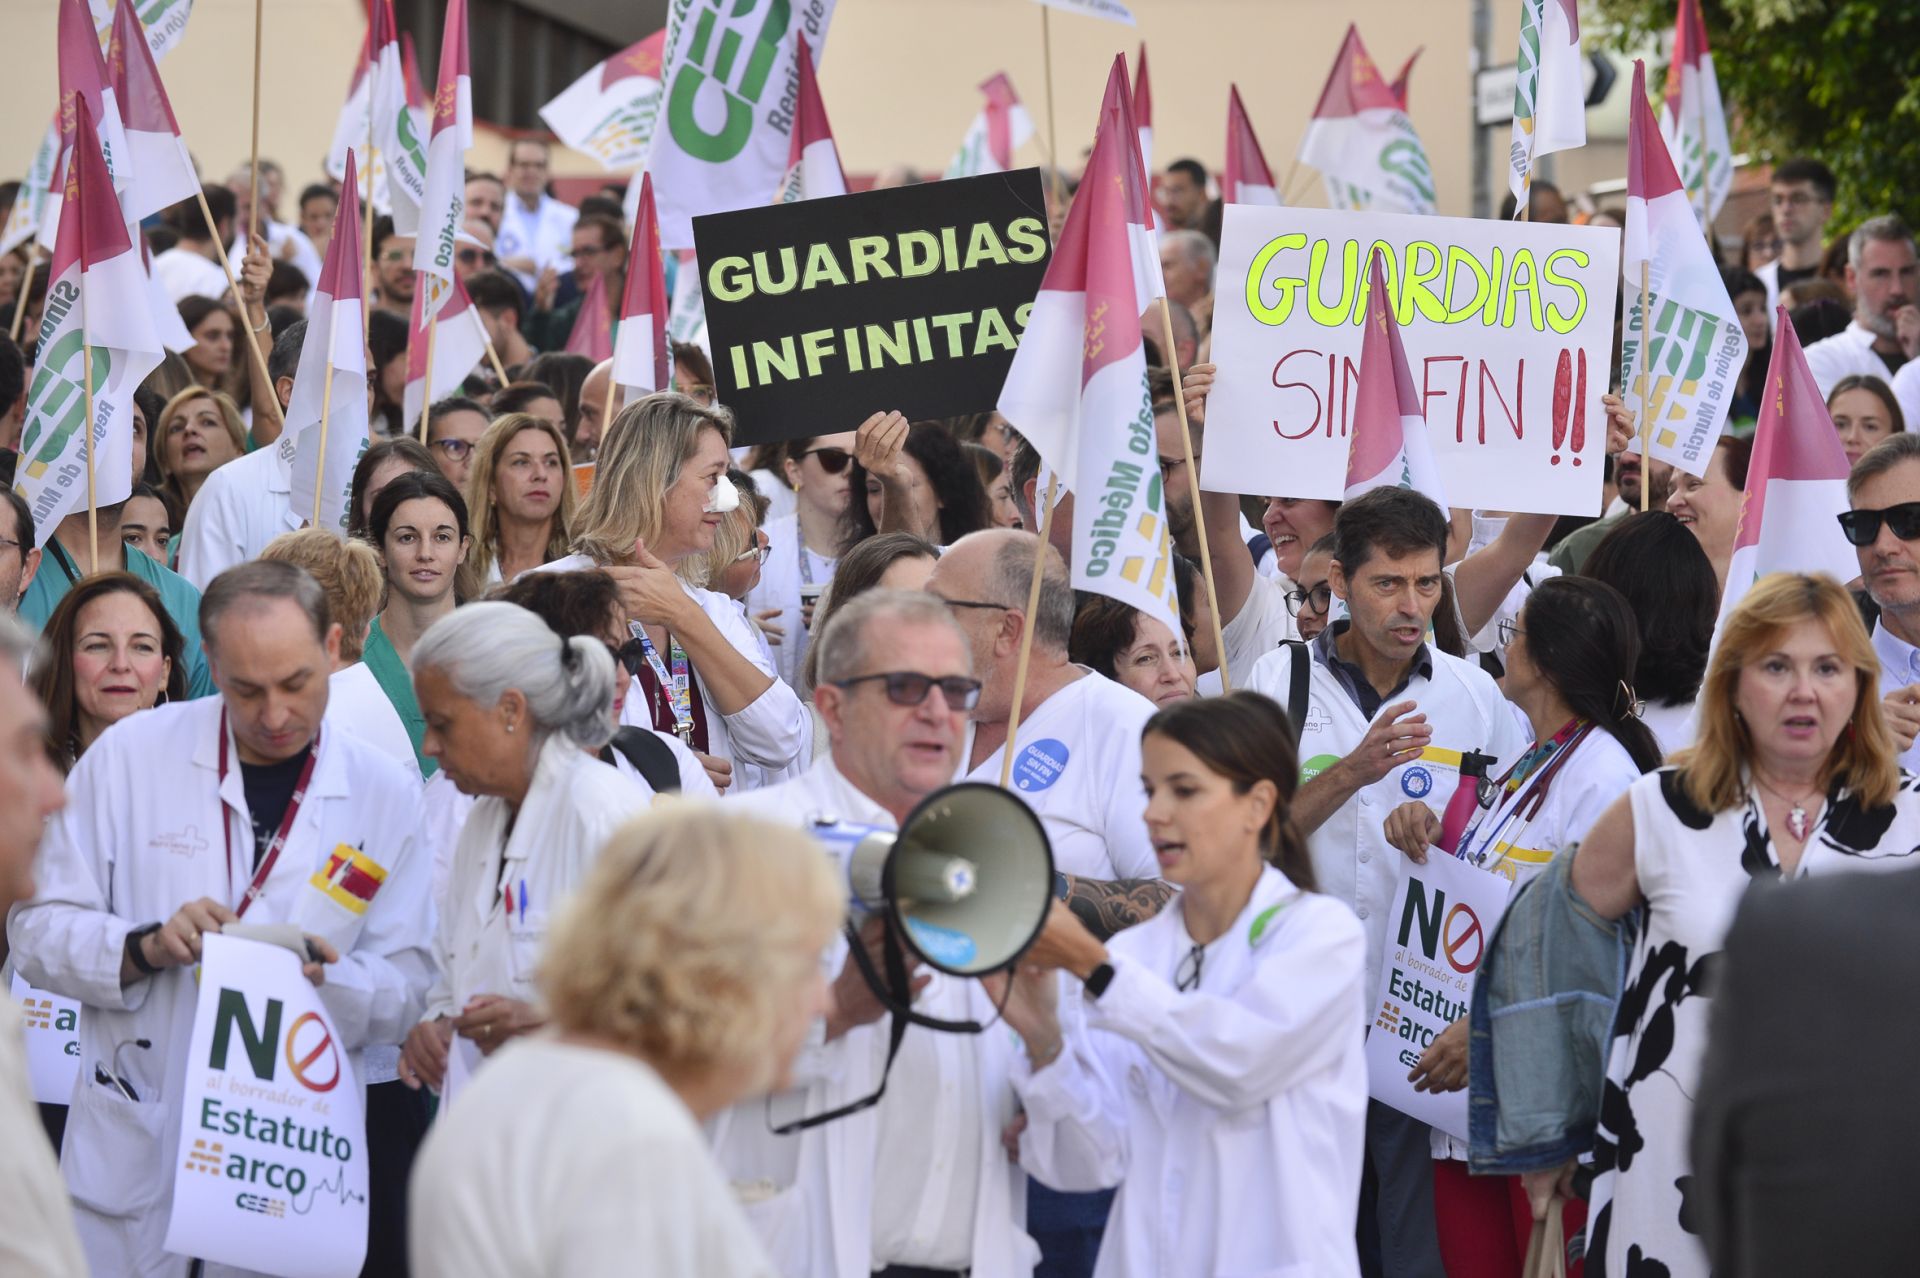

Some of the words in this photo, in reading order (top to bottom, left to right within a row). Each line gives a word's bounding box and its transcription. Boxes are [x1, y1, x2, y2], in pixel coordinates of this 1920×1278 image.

[707, 216, 1048, 303] GUARDIAS
[1245, 232, 1590, 335] GUARDIAS
[1394, 949, 1405, 963] al
[1407, 951, 1453, 985] borrador
[1454, 975, 1468, 993] de
[205, 1074, 222, 1091] al
[229, 1077, 308, 1108] borrador
[311, 1096, 332, 1116] de
[200, 1097, 352, 1163] Estatuto
